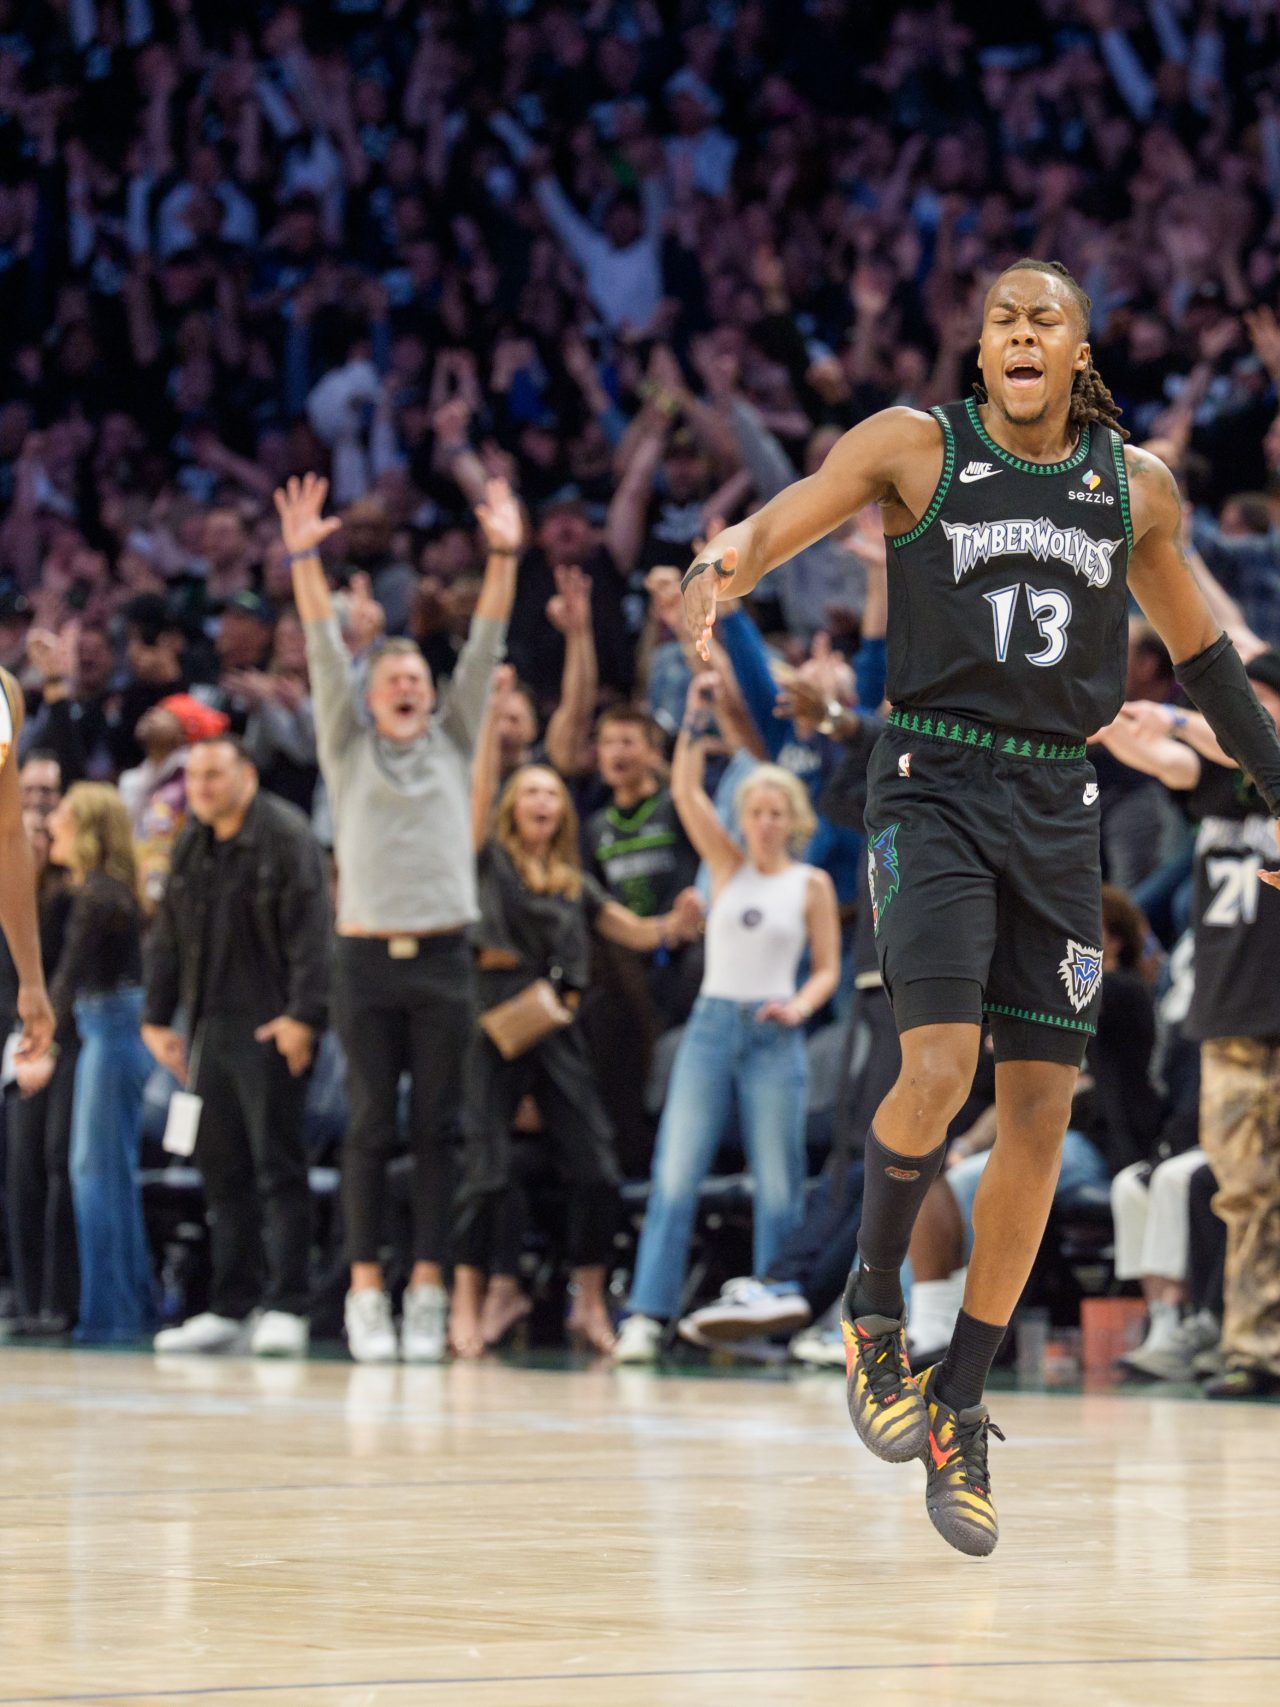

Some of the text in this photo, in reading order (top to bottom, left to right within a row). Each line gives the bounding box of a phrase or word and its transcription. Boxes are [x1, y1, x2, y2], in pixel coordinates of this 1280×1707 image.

[966, 461, 993, 475] NIKE
[1068, 490, 1114, 505] sezzle
[982, 583, 1072, 667] 13
[1202, 854, 1264, 928] 21
